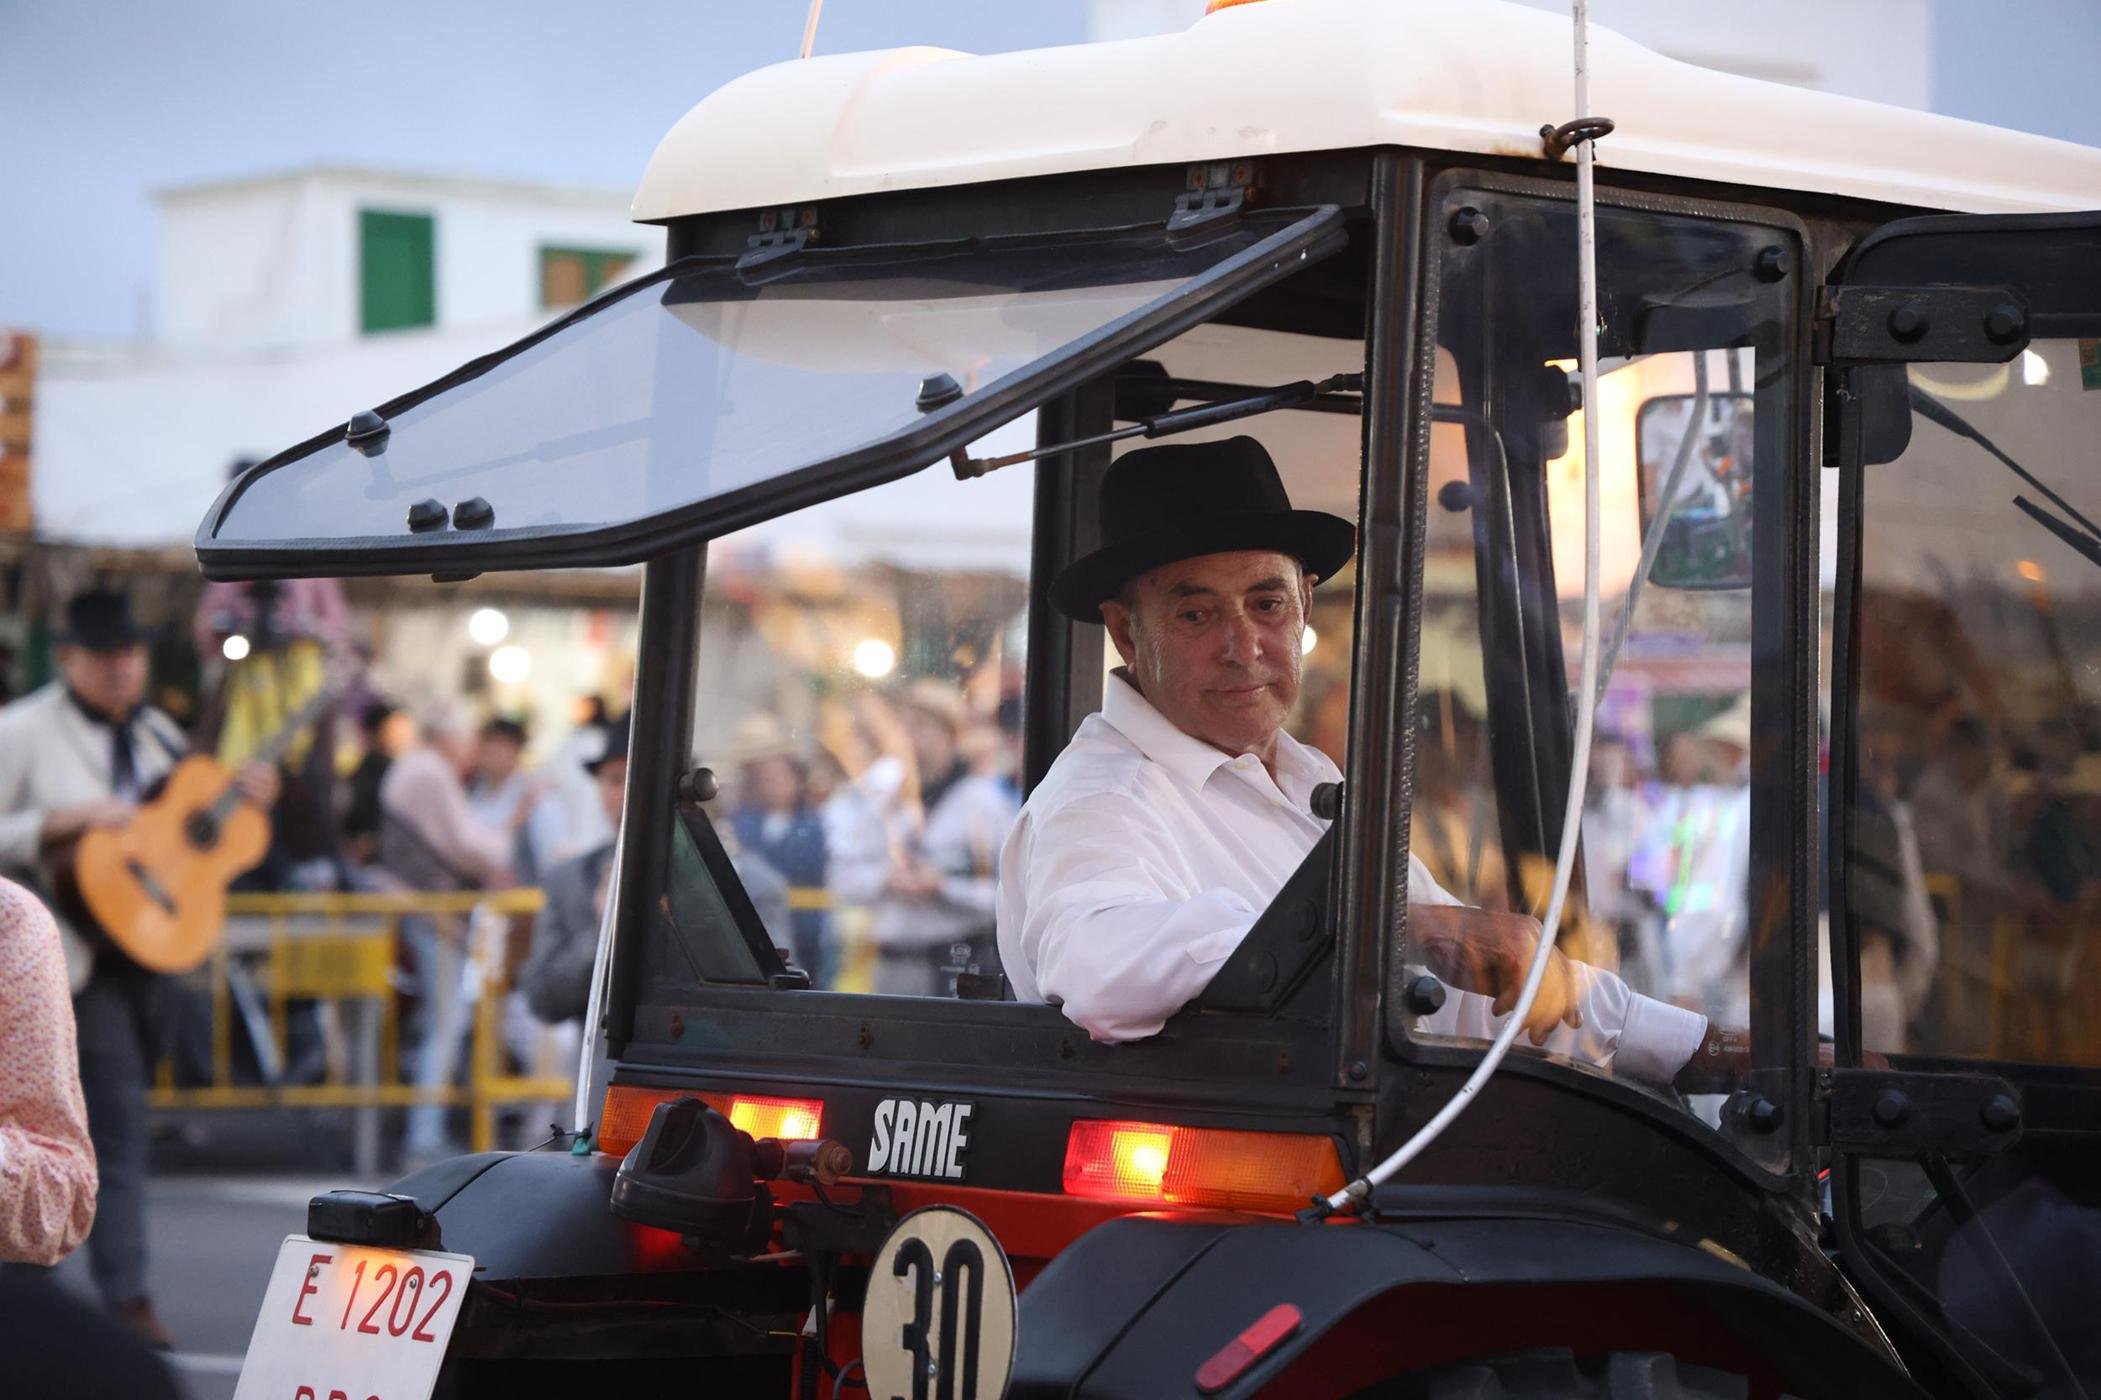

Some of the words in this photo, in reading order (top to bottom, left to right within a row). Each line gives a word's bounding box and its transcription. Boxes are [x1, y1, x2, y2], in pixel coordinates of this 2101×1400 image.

[867, 1099, 972, 1178] SAME
[291, 1254, 333, 1326] E
[340, 1259, 453, 1343] 1202
[893, 1237, 985, 1400] 30
